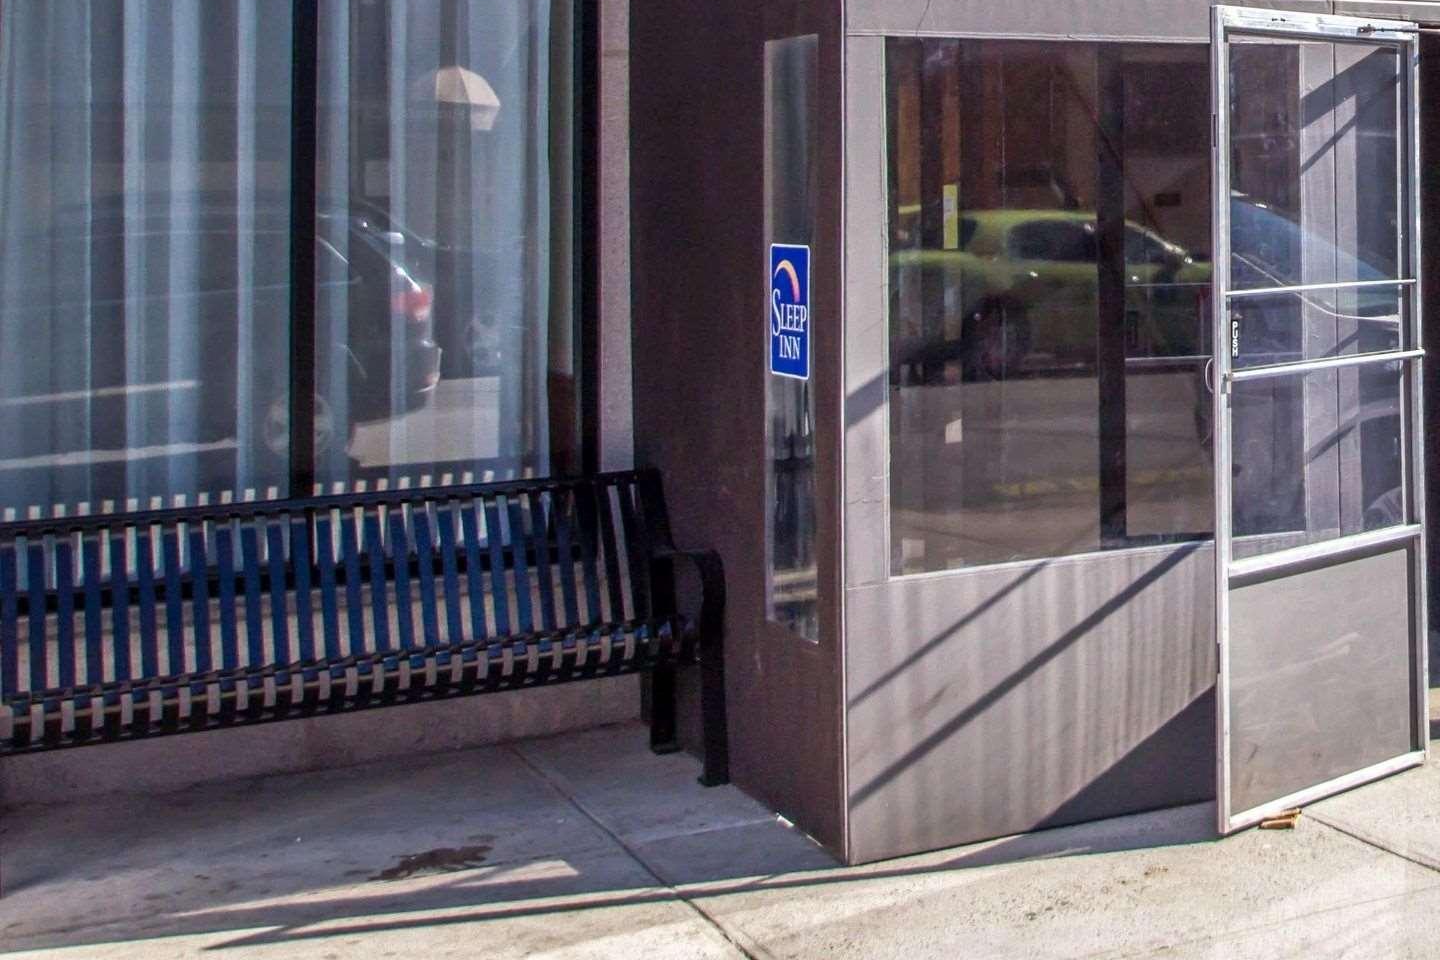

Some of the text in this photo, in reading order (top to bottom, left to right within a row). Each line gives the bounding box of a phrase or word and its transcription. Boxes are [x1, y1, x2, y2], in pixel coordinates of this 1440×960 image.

[772, 288, 807, 337] SLEEP
[779, 334, 801, 360] INN
[1231, 320, 1239, 358] PUSH
